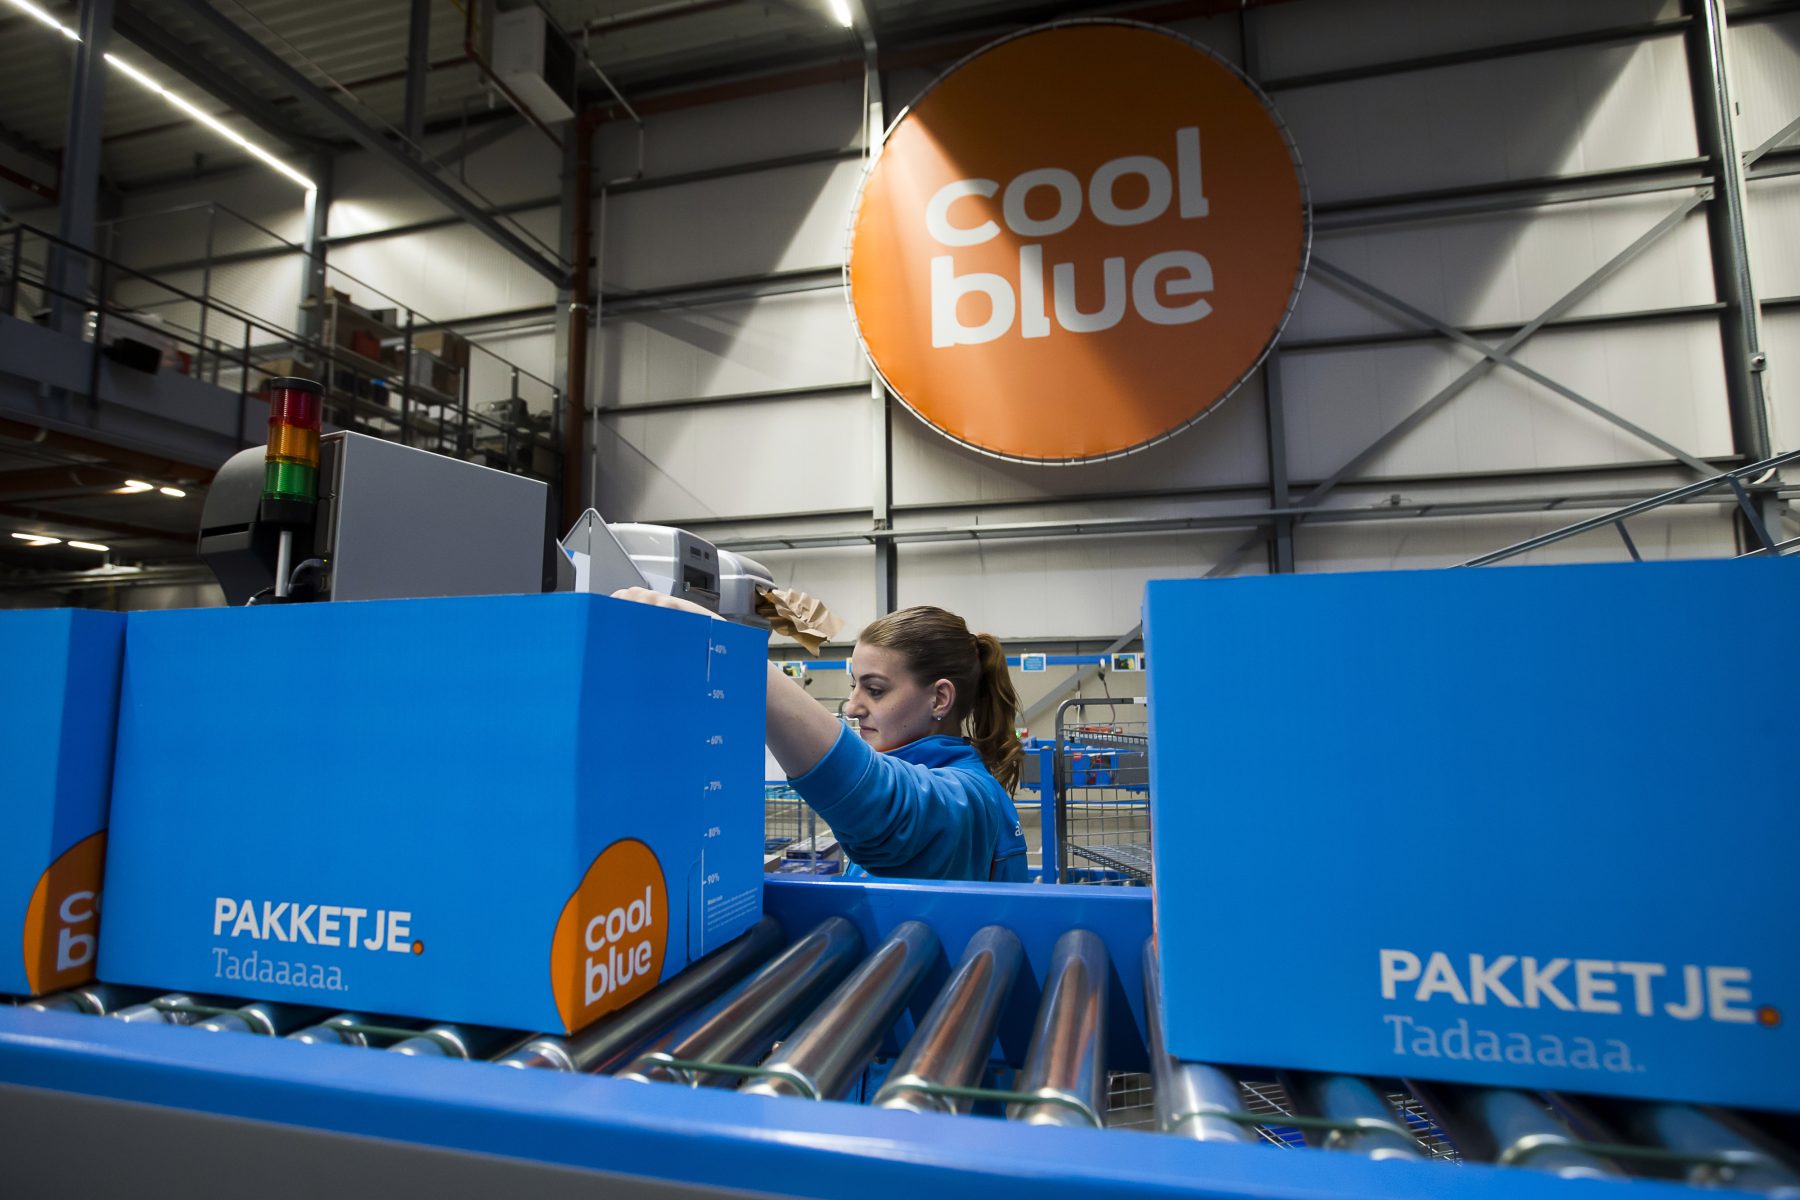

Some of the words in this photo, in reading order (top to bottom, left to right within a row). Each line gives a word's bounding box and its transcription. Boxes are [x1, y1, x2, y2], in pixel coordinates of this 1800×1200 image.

[925, 126, 1209, 247] cool
[930, 244, 1214, 348] blue
[709, 781, 722, 791] 70%
[59, 890, 101, 923] c
[707, 872, 720, 885] 90%
[585, 885, 652, 952] cool
[212, 946, 349, 992] Tadaaaaa.
[584, 940, 652, 1007] blue
[1383, 1014, 1646, 1073] Tadaaaaa.
